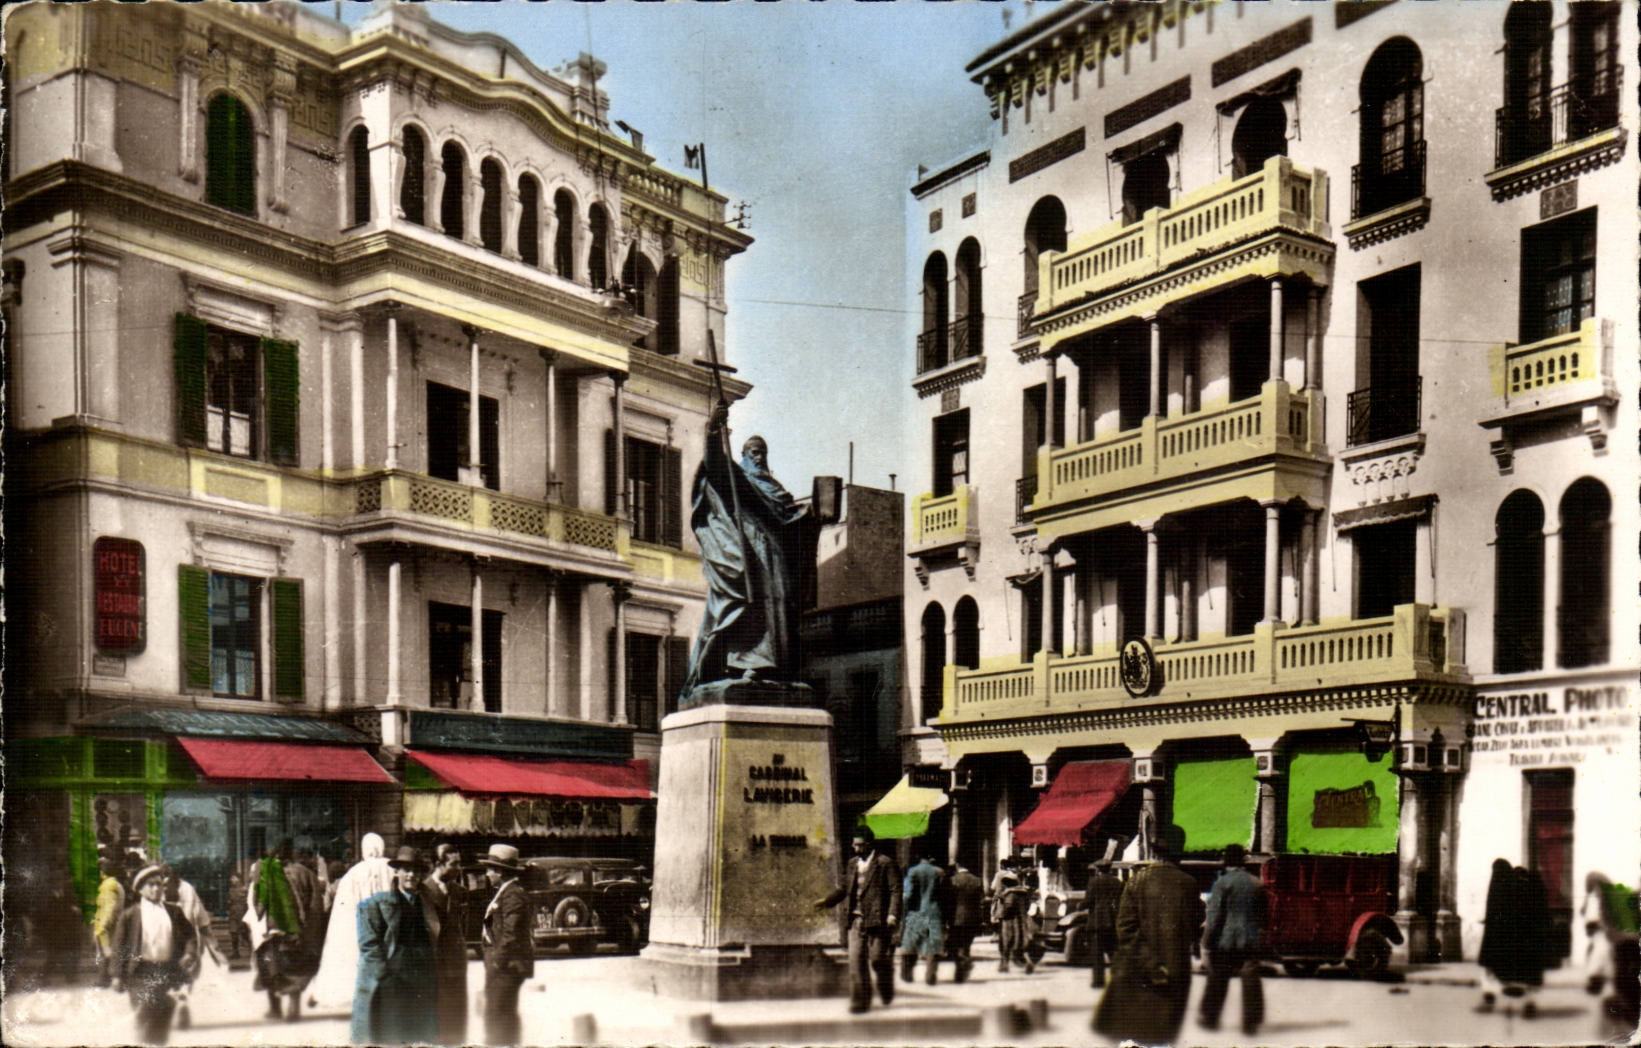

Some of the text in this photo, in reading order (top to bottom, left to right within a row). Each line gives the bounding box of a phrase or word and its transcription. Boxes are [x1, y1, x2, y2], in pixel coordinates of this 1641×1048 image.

[99, 552, 142, 576] HOTEL
[1473, 686, 1628, 719] CENTRAL PHOTO
[749, 765, 808, 781] CARDINAL
[743, 787, 814, 804] LAVIGERIE
